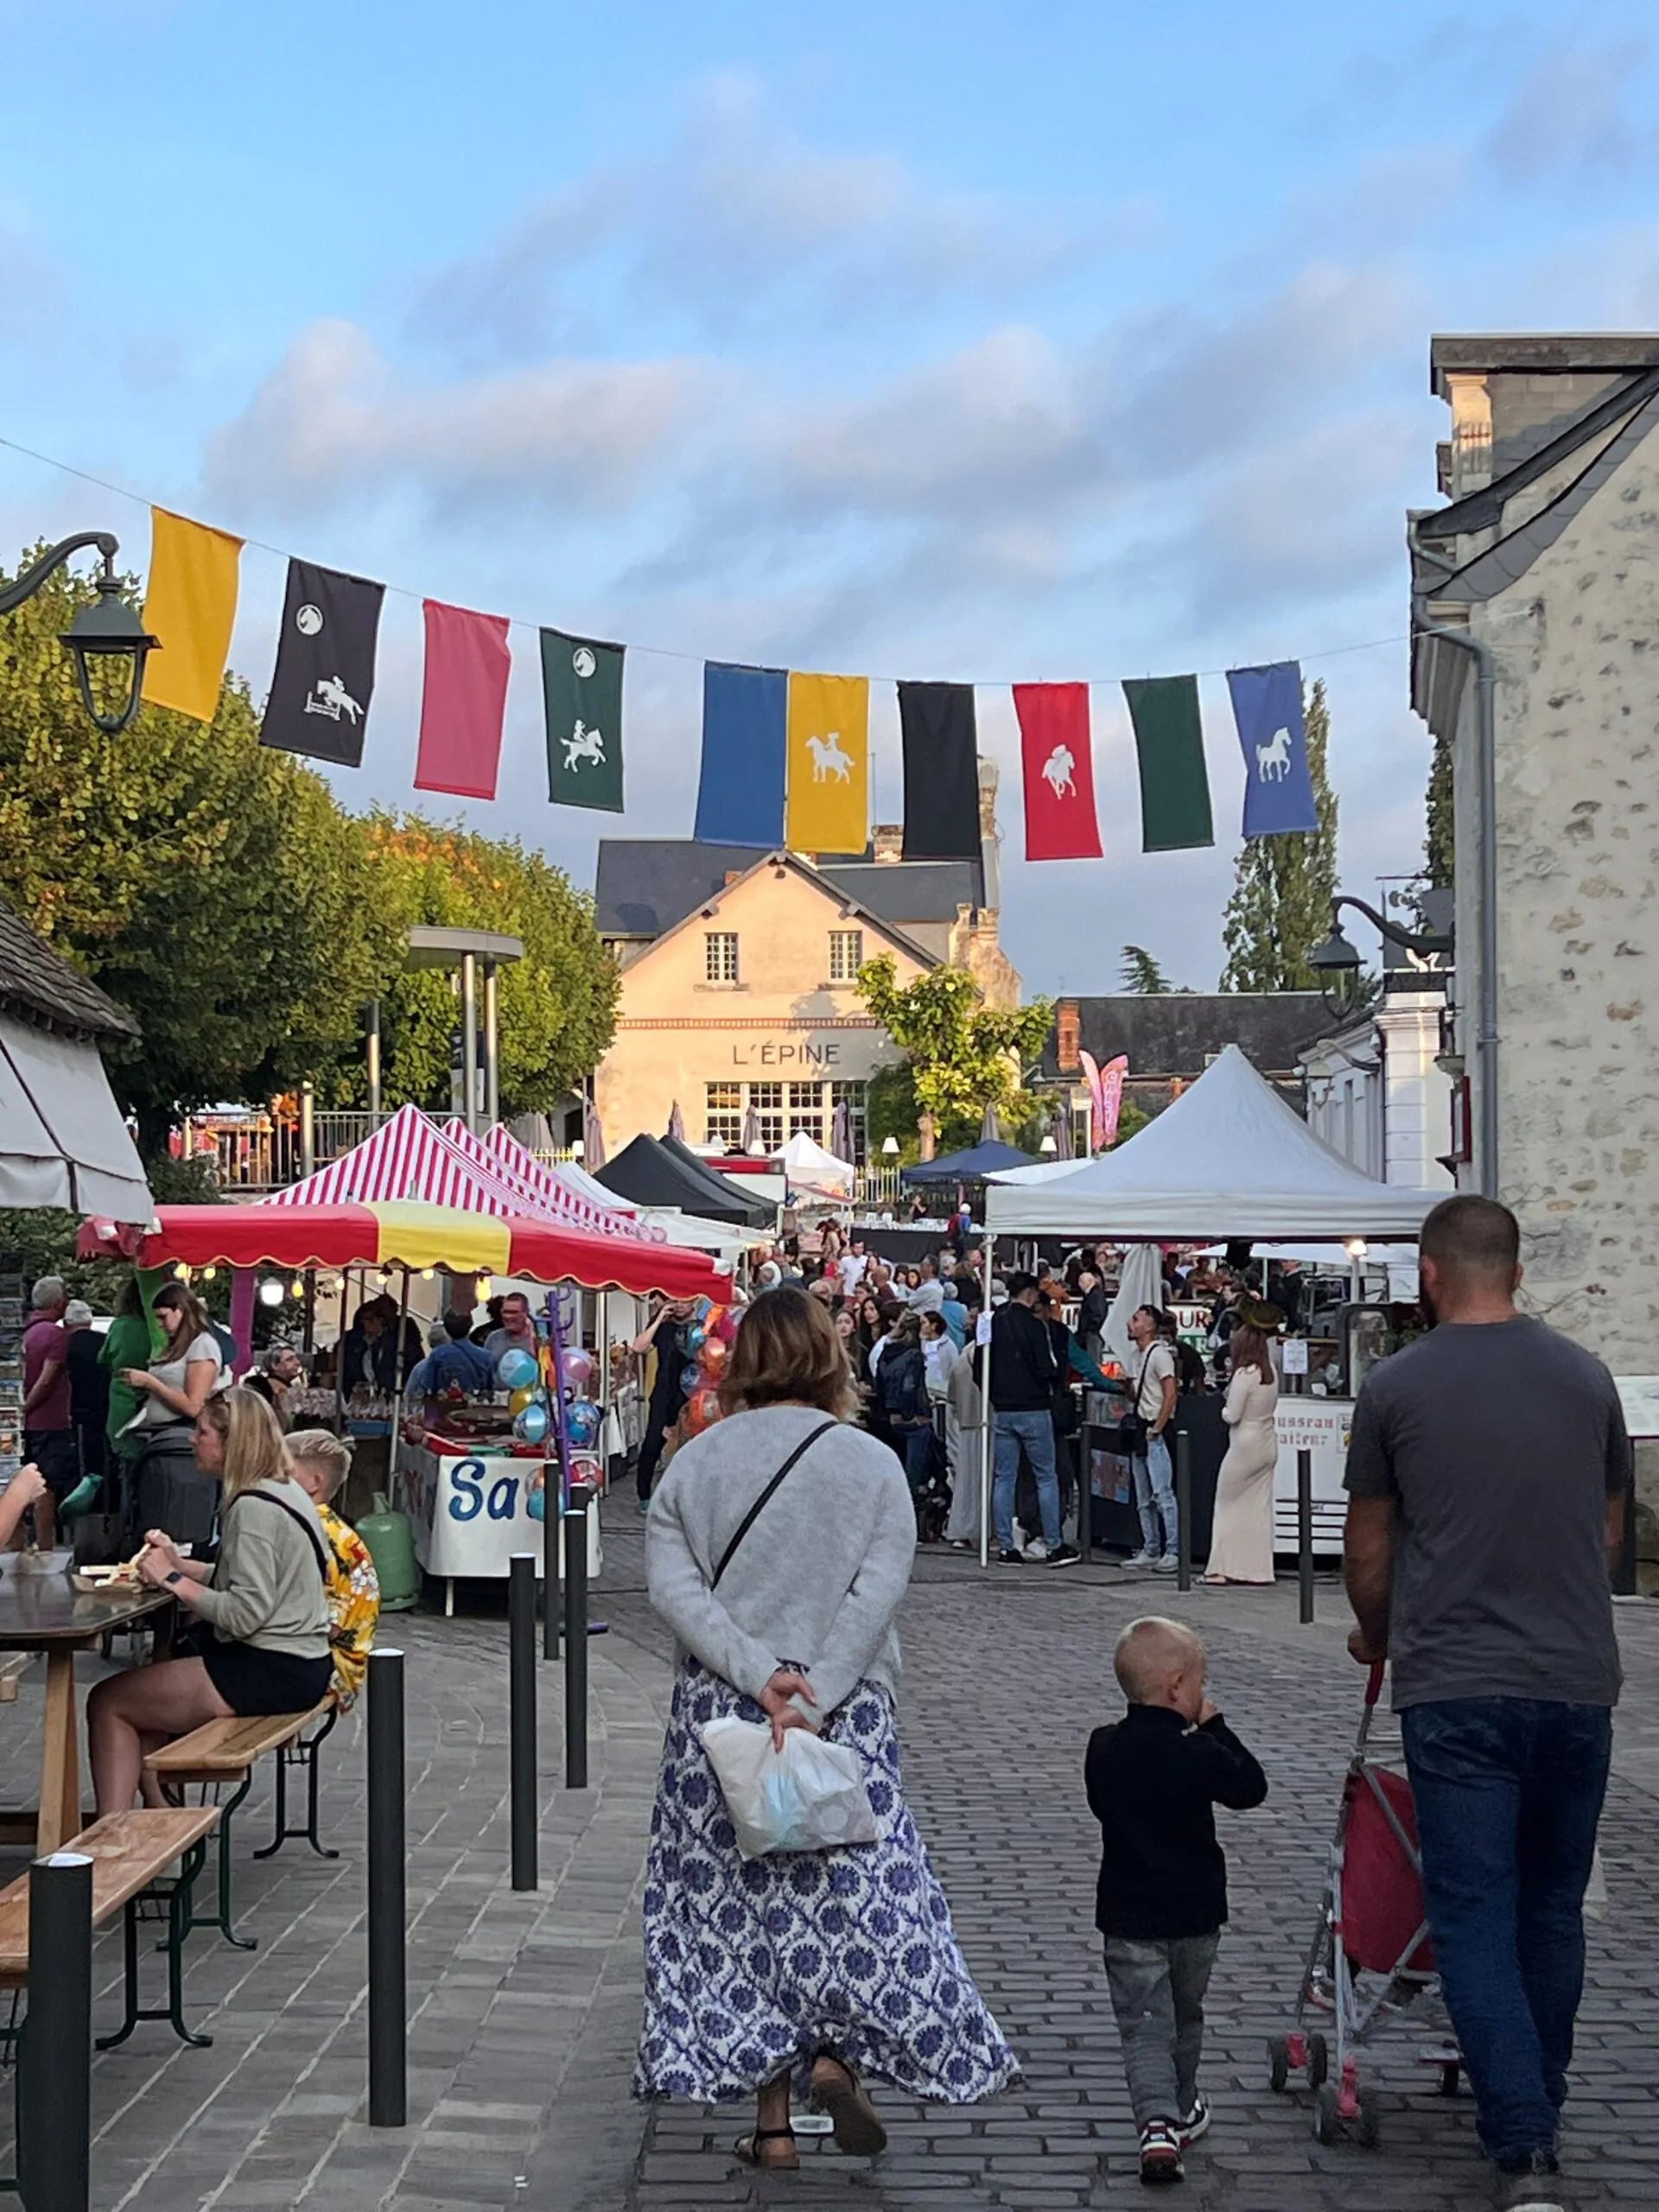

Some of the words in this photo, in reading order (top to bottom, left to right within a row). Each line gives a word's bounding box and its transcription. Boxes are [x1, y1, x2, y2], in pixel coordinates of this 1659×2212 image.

[733, 1039, 841, 1065] L'ÉPINE
[1179, 1310, 1208, 1329] UR
[448, 1457, 537, 1522] Sa
